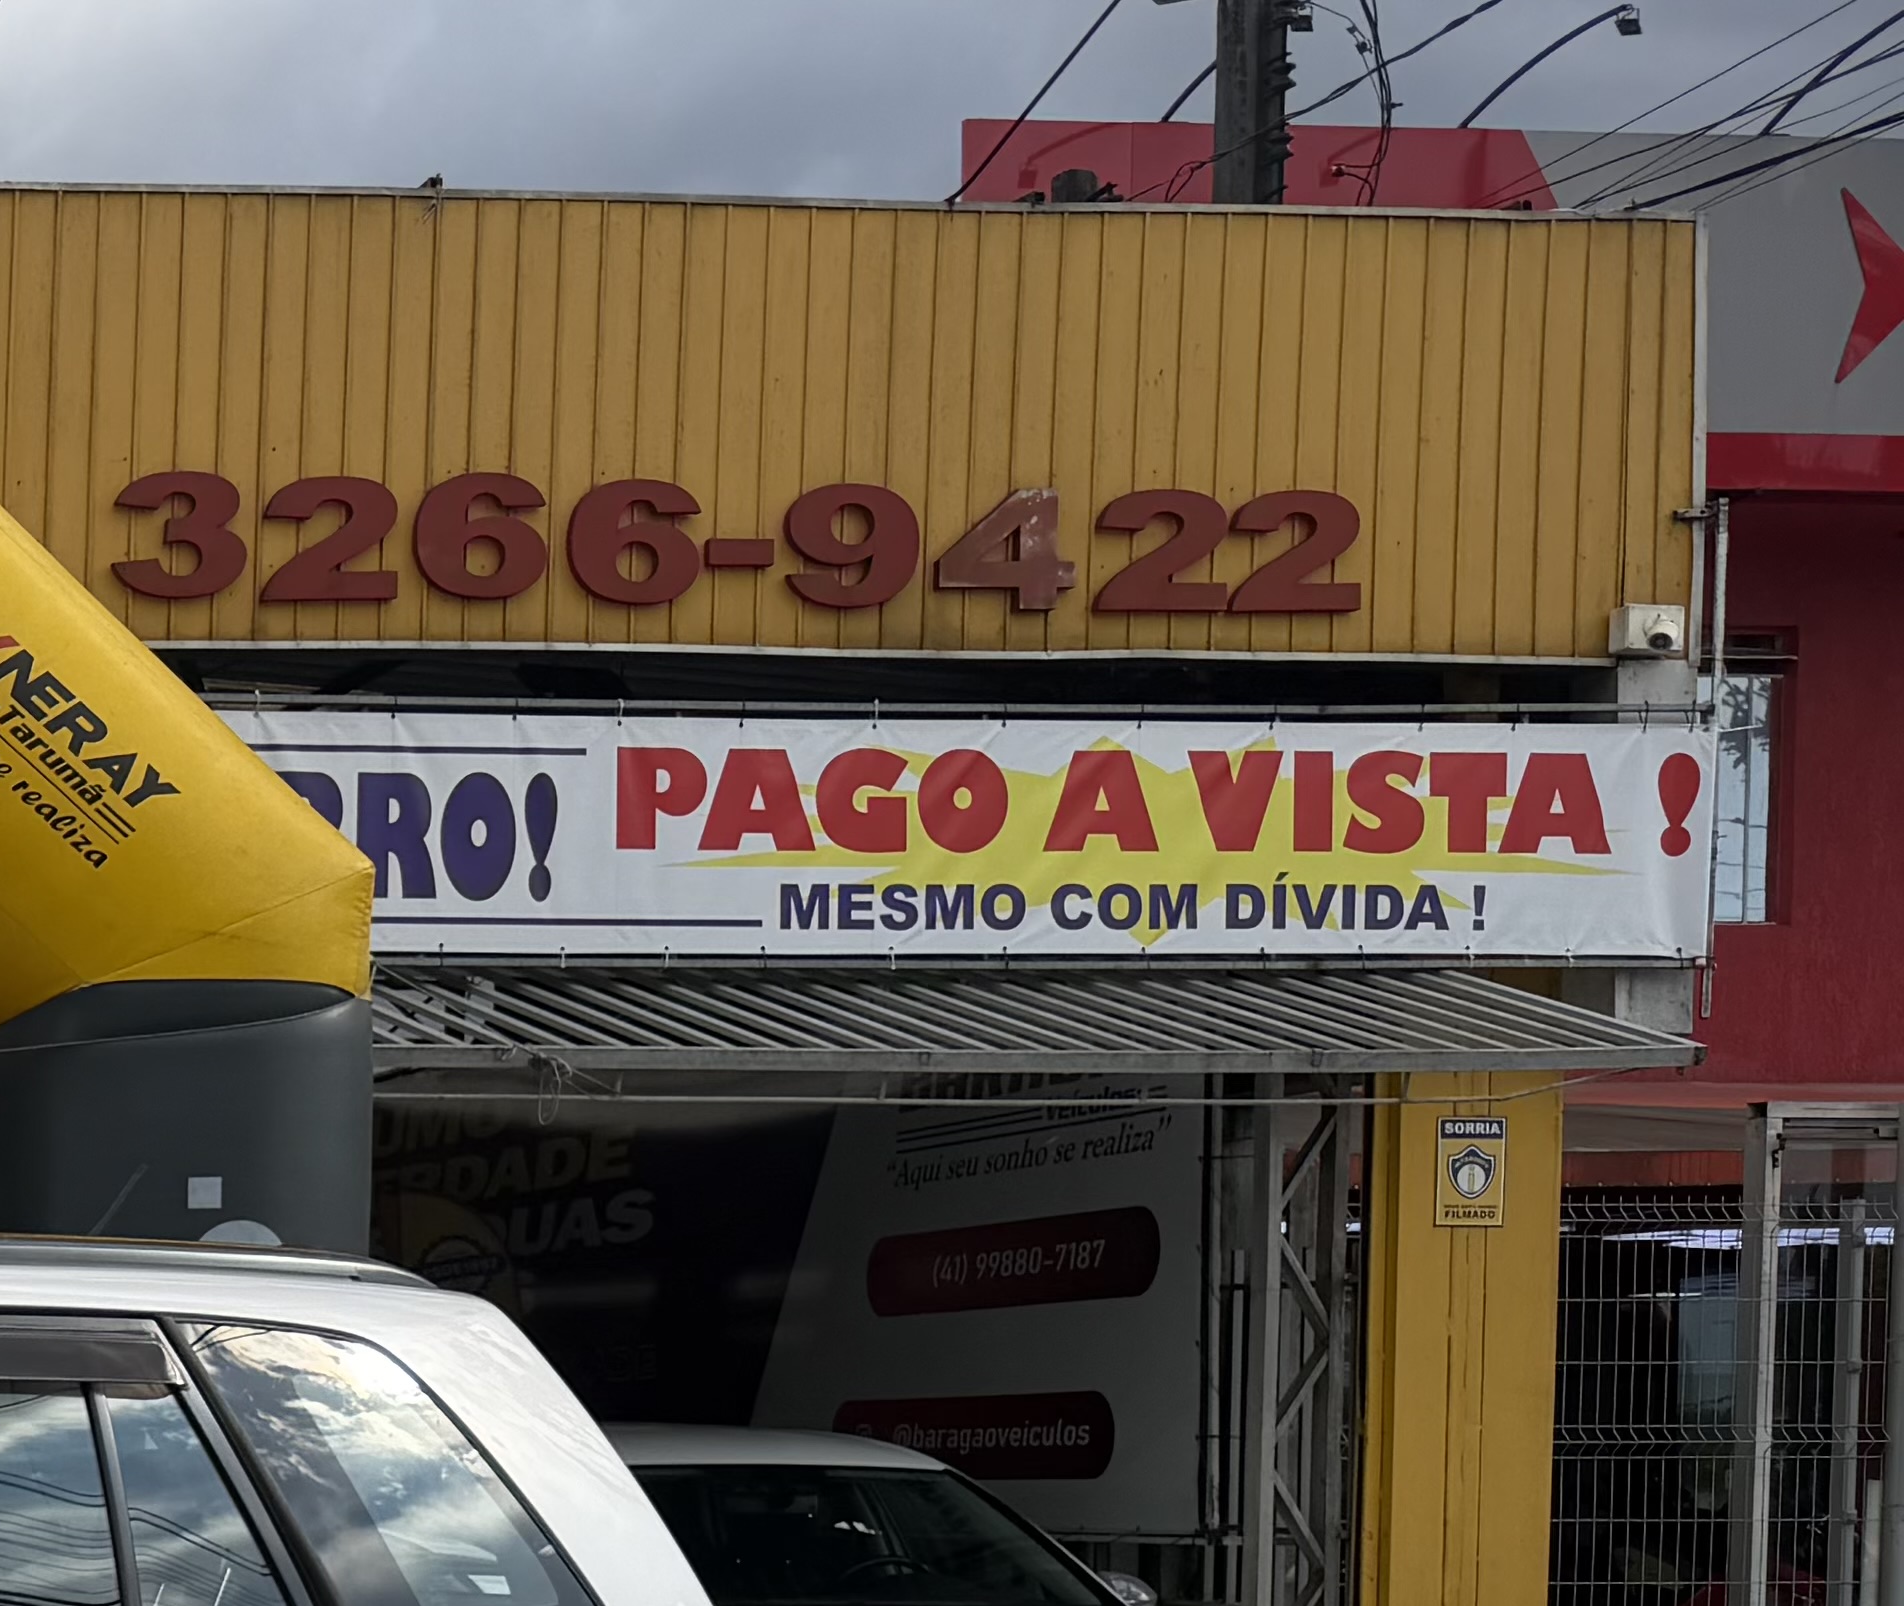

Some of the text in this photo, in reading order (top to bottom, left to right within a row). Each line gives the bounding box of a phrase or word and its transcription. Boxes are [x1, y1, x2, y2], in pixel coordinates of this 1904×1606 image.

[111, 470, 1363, 614] 3266-9422
[11, 778, 110, 869] realiza
[616, 745, 1009, 852] PAGO
[1043, 750, 1161, 853] A
[1187, 749, 1612, 855] VISTA
[778, 880, 1027, 933] MESMO
[1049, 882, 1198, 934] COM
[1224, 869, 1448, 933] DÍVIDA
[1444, 1121, 1502, 1135] SORRIA
[1444, 1210, 1496, 1220] FILMADO
[976, 1239, 1106, 1279] 99880-7187
